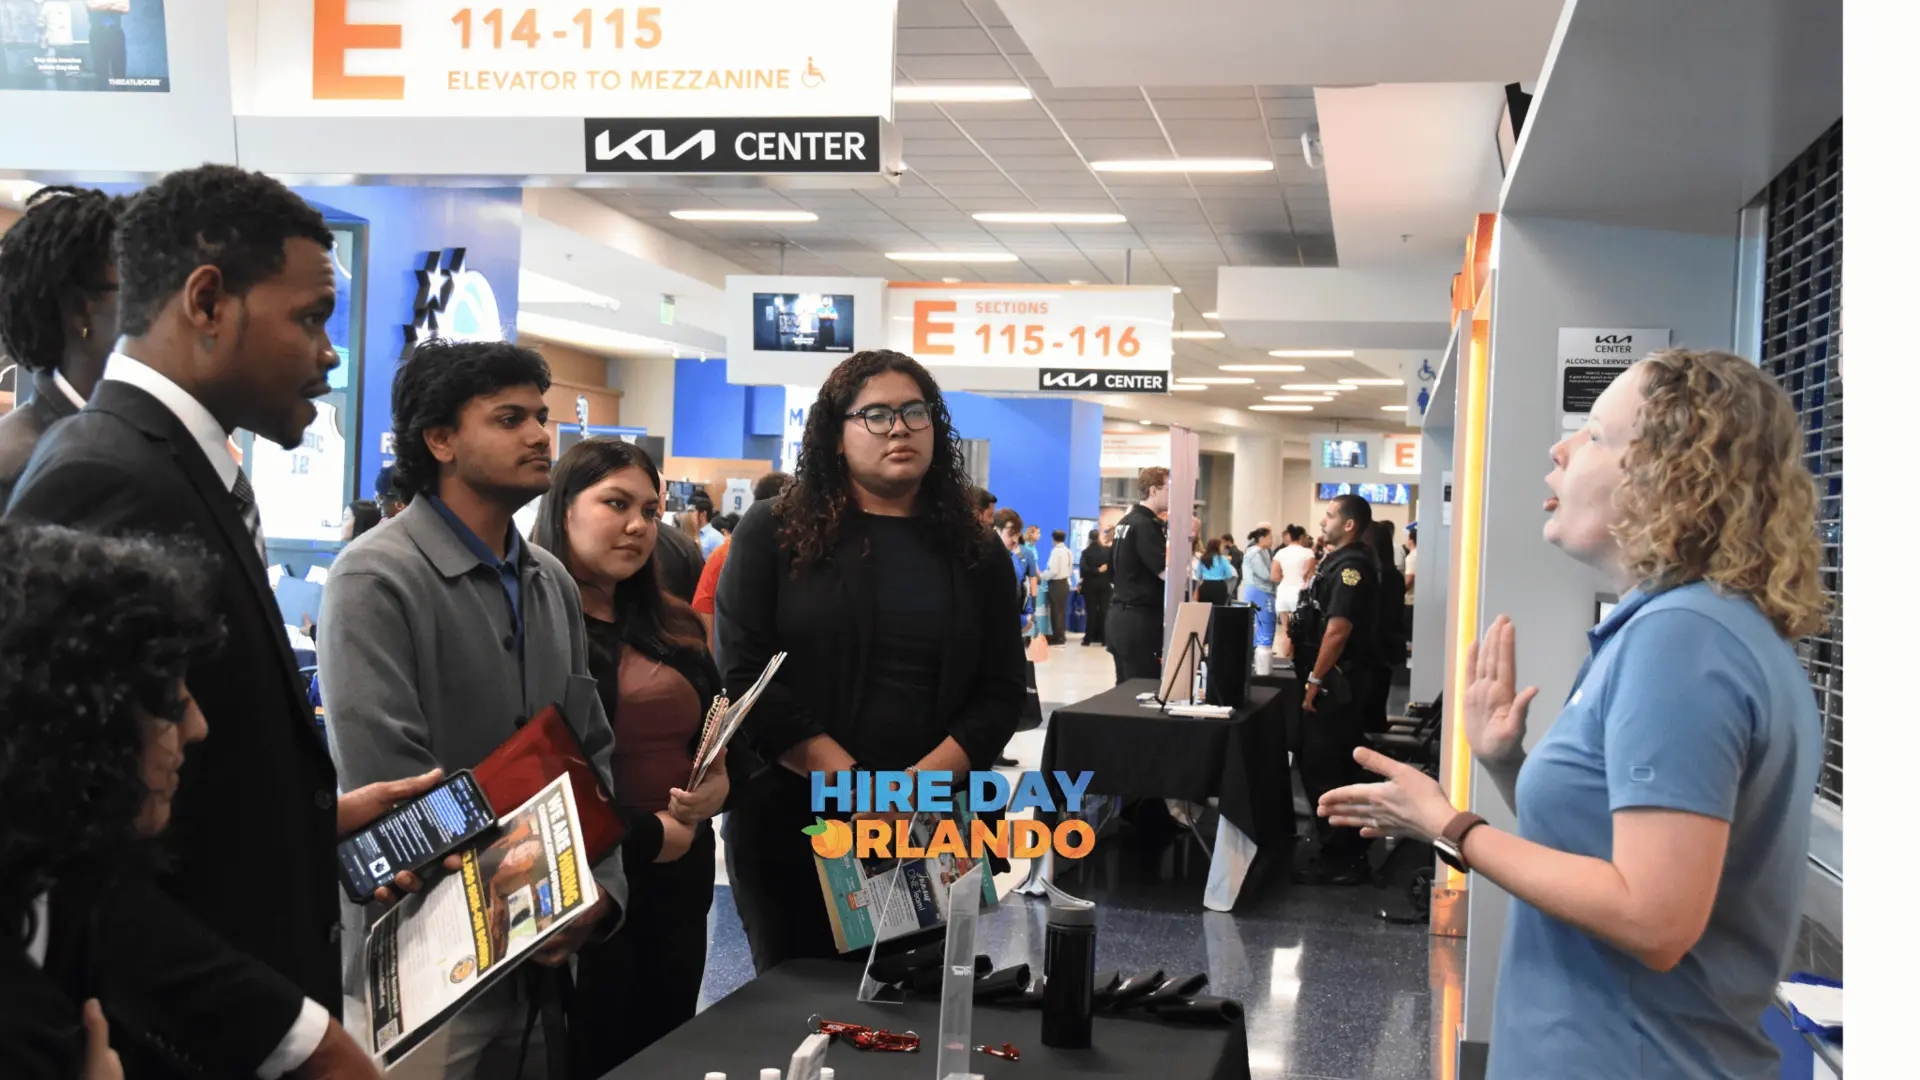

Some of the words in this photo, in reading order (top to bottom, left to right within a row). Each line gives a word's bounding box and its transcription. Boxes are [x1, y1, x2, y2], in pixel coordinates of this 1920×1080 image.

[313, 0, 405, 100] E
[448, 70, 576, 90] ELEVATOR
[588, 70, 621, 89] TO
[631, 68, 790, 90] MEZZANINE
[734, 131, 867, 161] CENTER
[975, 301, 1049, 315] SECTIONS
[913, 300, 957, 355] E
[975, 323, 1141, 358] 115-116
[1595, 345, 1632, 353] CENTER
[1104, 373, 1163, 389] CENTER
[1395, 443, 1416, 468] E
[547, 791, 566, 823] WE
[551, 819, 571, 854] ARE
[557, 847, 579, 907] HIRING
[907, 869, 919, 888] ONE
